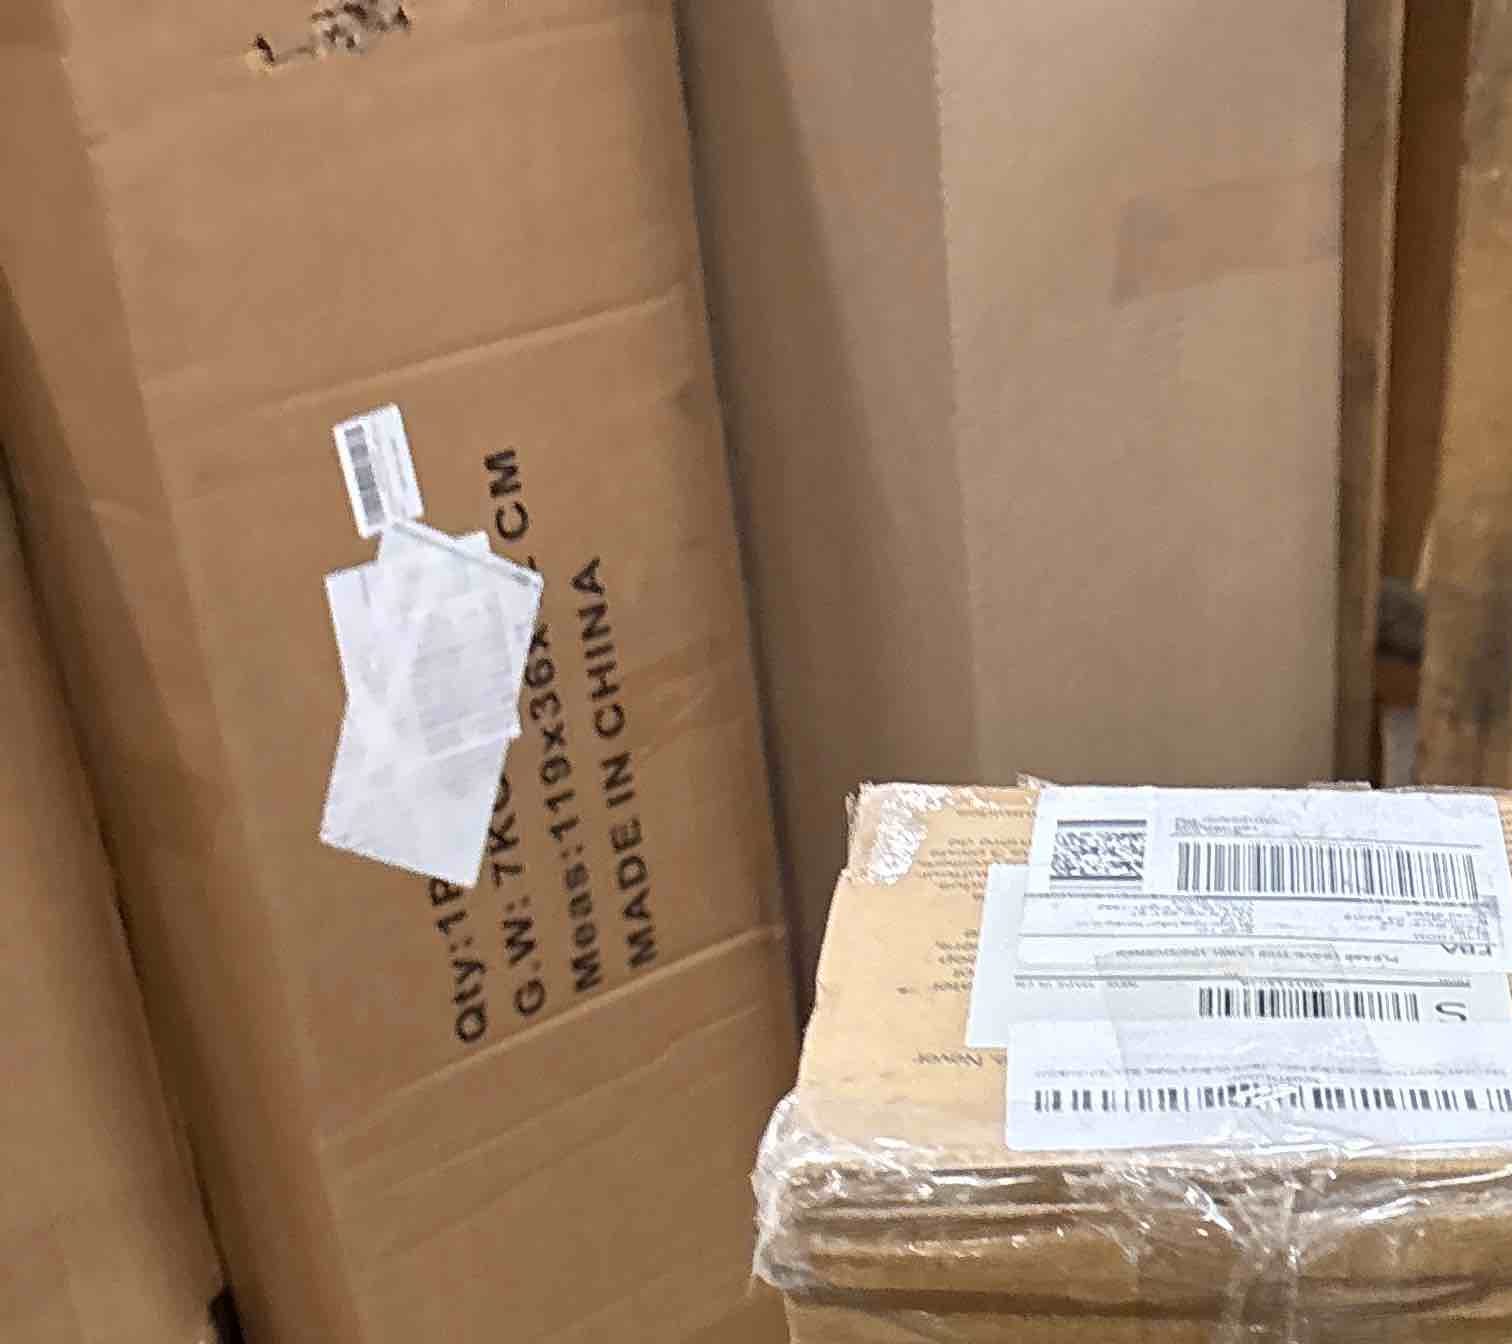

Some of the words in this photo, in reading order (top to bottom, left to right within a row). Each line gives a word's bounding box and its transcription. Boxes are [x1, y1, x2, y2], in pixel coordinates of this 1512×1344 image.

[484, 449, 529, 541] CM
[570, 555, 626, 740] CHINA
[600, 751, 636, 809] IN
[609, 817, 658, 970] MADE
